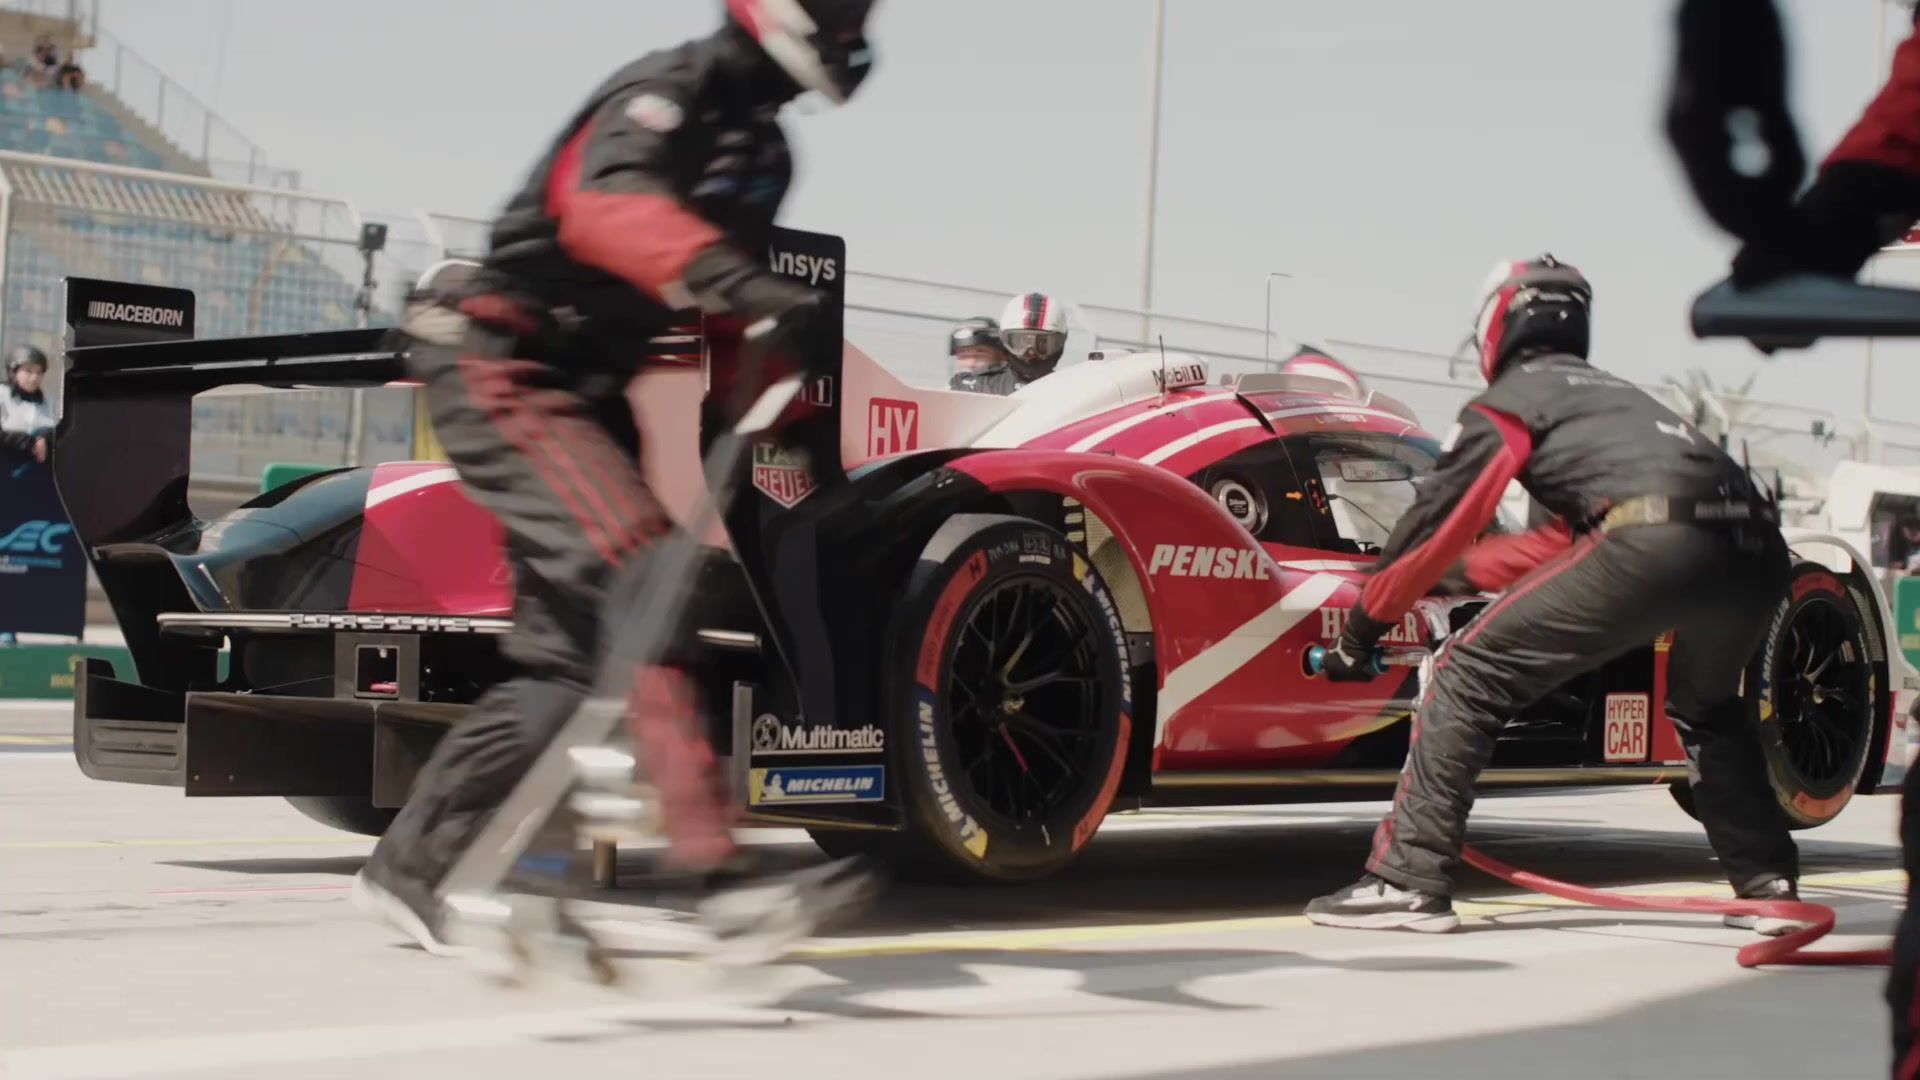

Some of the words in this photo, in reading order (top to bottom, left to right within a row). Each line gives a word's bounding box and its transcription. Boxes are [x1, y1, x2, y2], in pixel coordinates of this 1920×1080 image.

[105, 302, 184, 328] RACEBORN
[1152, 366, 1190, 386] Mobil
[869, 404, 915, 456] HY
[1148, 543, 1271, 581] PENSKE
[1095, 588, 1132, 703] MICHELIN
[1608, 699, 1646, 720] HYPER
[781, 724, 884, 750] Multimatic
[1608, 721, 1645, 754] CAR
[918, 700, 964, 823] MICHELIN
[786, 777, 875, 793] MICHELIN
